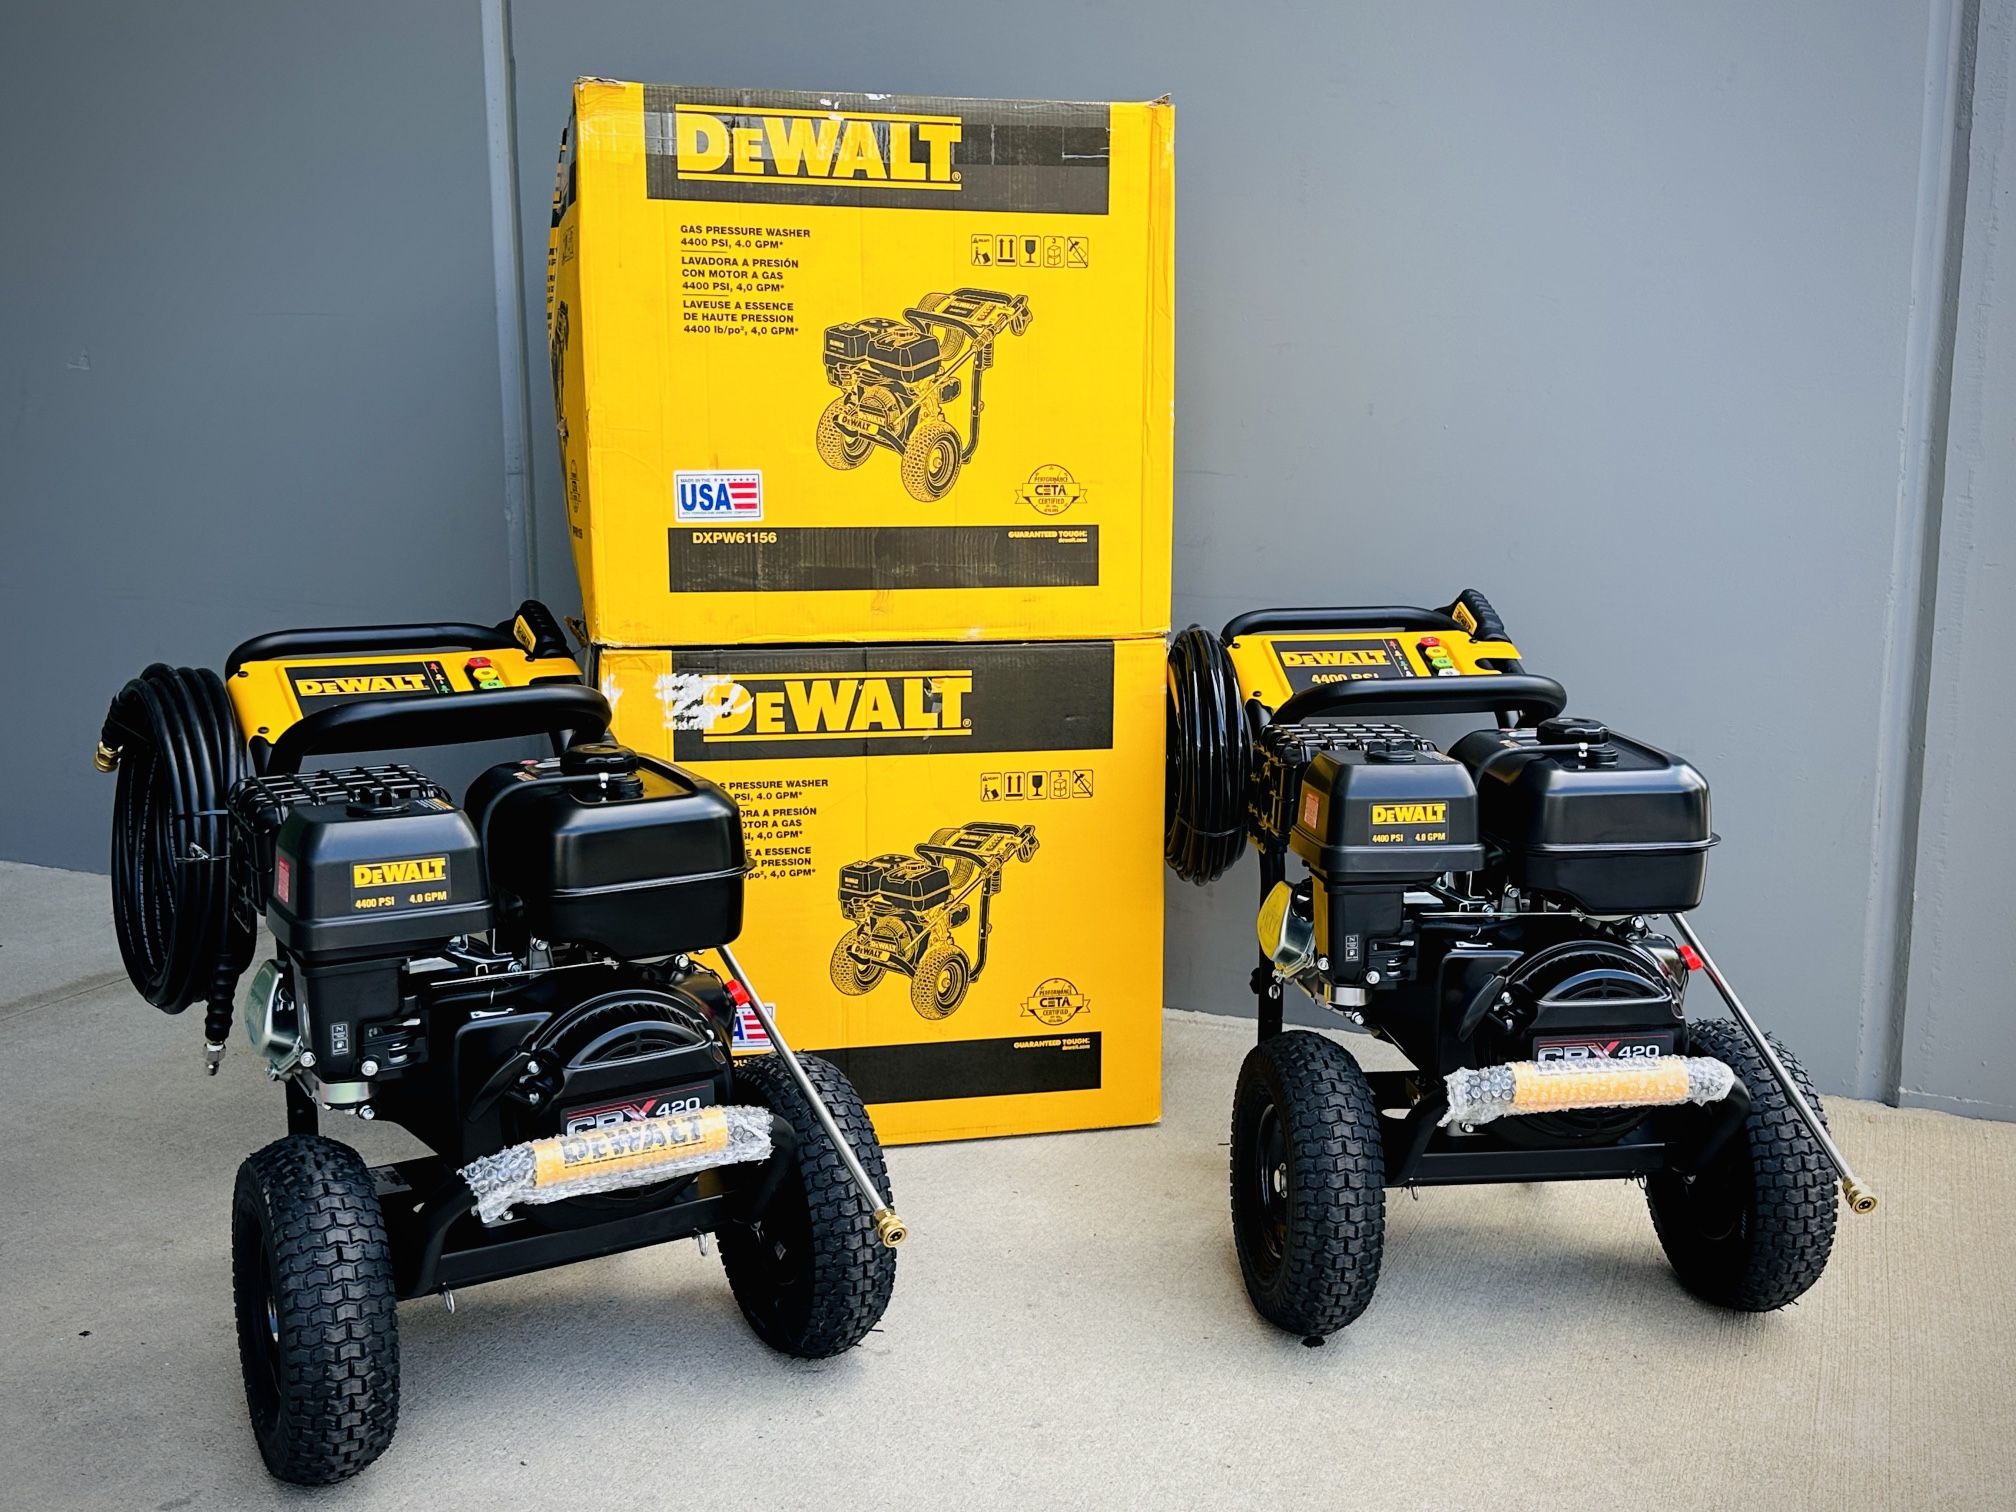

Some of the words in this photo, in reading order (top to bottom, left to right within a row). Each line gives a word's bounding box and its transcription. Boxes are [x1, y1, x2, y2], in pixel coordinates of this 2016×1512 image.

[681, 225, 702, 234] GAS
[706, 226, 763, 236] PRESSURE
[766, 228, 811, 237] WASHER
[681, 238, 708, 246] 4400
[711, 238, 732, 248] PSI,
[735, 240, 751, 248] 4.0
[681, 256, 739, 266] LAVADORA
[742, 259, 749, 267] A
[752, 258, 799, 268] PRESIÓN
[682, 269, 705, 277] CON
[709, 270, 748, 279] MOTOR
[751, 271, 759, 279] A
[762, 271, 783, 280] GAS
[682, 282, 709, 290] 4400
[713, 282, 733, 292] PSI,
[736, 284, 753, 292] 4,0
[683, 300, 731, 309] LAVEUSE
[735, 302, 741, 310] A
[745, 302, 794, 311] ESSENCE
[684, 313, 698, 321] DE
[702, 313, 737, 322] HAUTE
[741, 314, 794, 323] PRESSION
[684, 325, 710, 333] 4400
[751, 327, 767, 336] 4,0
[1034, 485, 1067, 496] CETA
[680, 483, 732, 511] USA
[692, 532, 778, 544] DXPW61156
[1008, 531, 1058, 539] GUARANTEED
[729, 781, 782, 790] PRESSURE
[786, 779, 829, 788] WASHER
[734, 793, 754, 802] PSI,
[756, 792, 772, 800] 4.0
[762, 809, 770, 817] A
[772, 806, 817, 816] PRESIÓN
[781, 819, 802, 828] GAS
[757, 831, 773, 840] 4,0
[1372, 834, 1389, 843] 4400
[1390, 833, 1404, 842] PSI
[1414, 833, 1426, 842] 4.0
[1427, 832, 1446, 841] GPM
[754, 849, 762, 857] A
[765, 847, 812, 856] ESSENCE
[761, 857, 812, 867] PRESSION
[770, 870, 786, 879] 4,0
[355, 899, 377, 909] 4400
[378, 896, 395, 907] PSI
[409, 894, 423, 904] 4.0
[424, 891, 447, 903] GPM
[1039, 997, 1071, 1008] CETA
[1013, 1039, 1062, 1049] GUARANTEED
[1617, 1045, 1660, 1058] 420
[655, 1097, 701, 1116] 420
